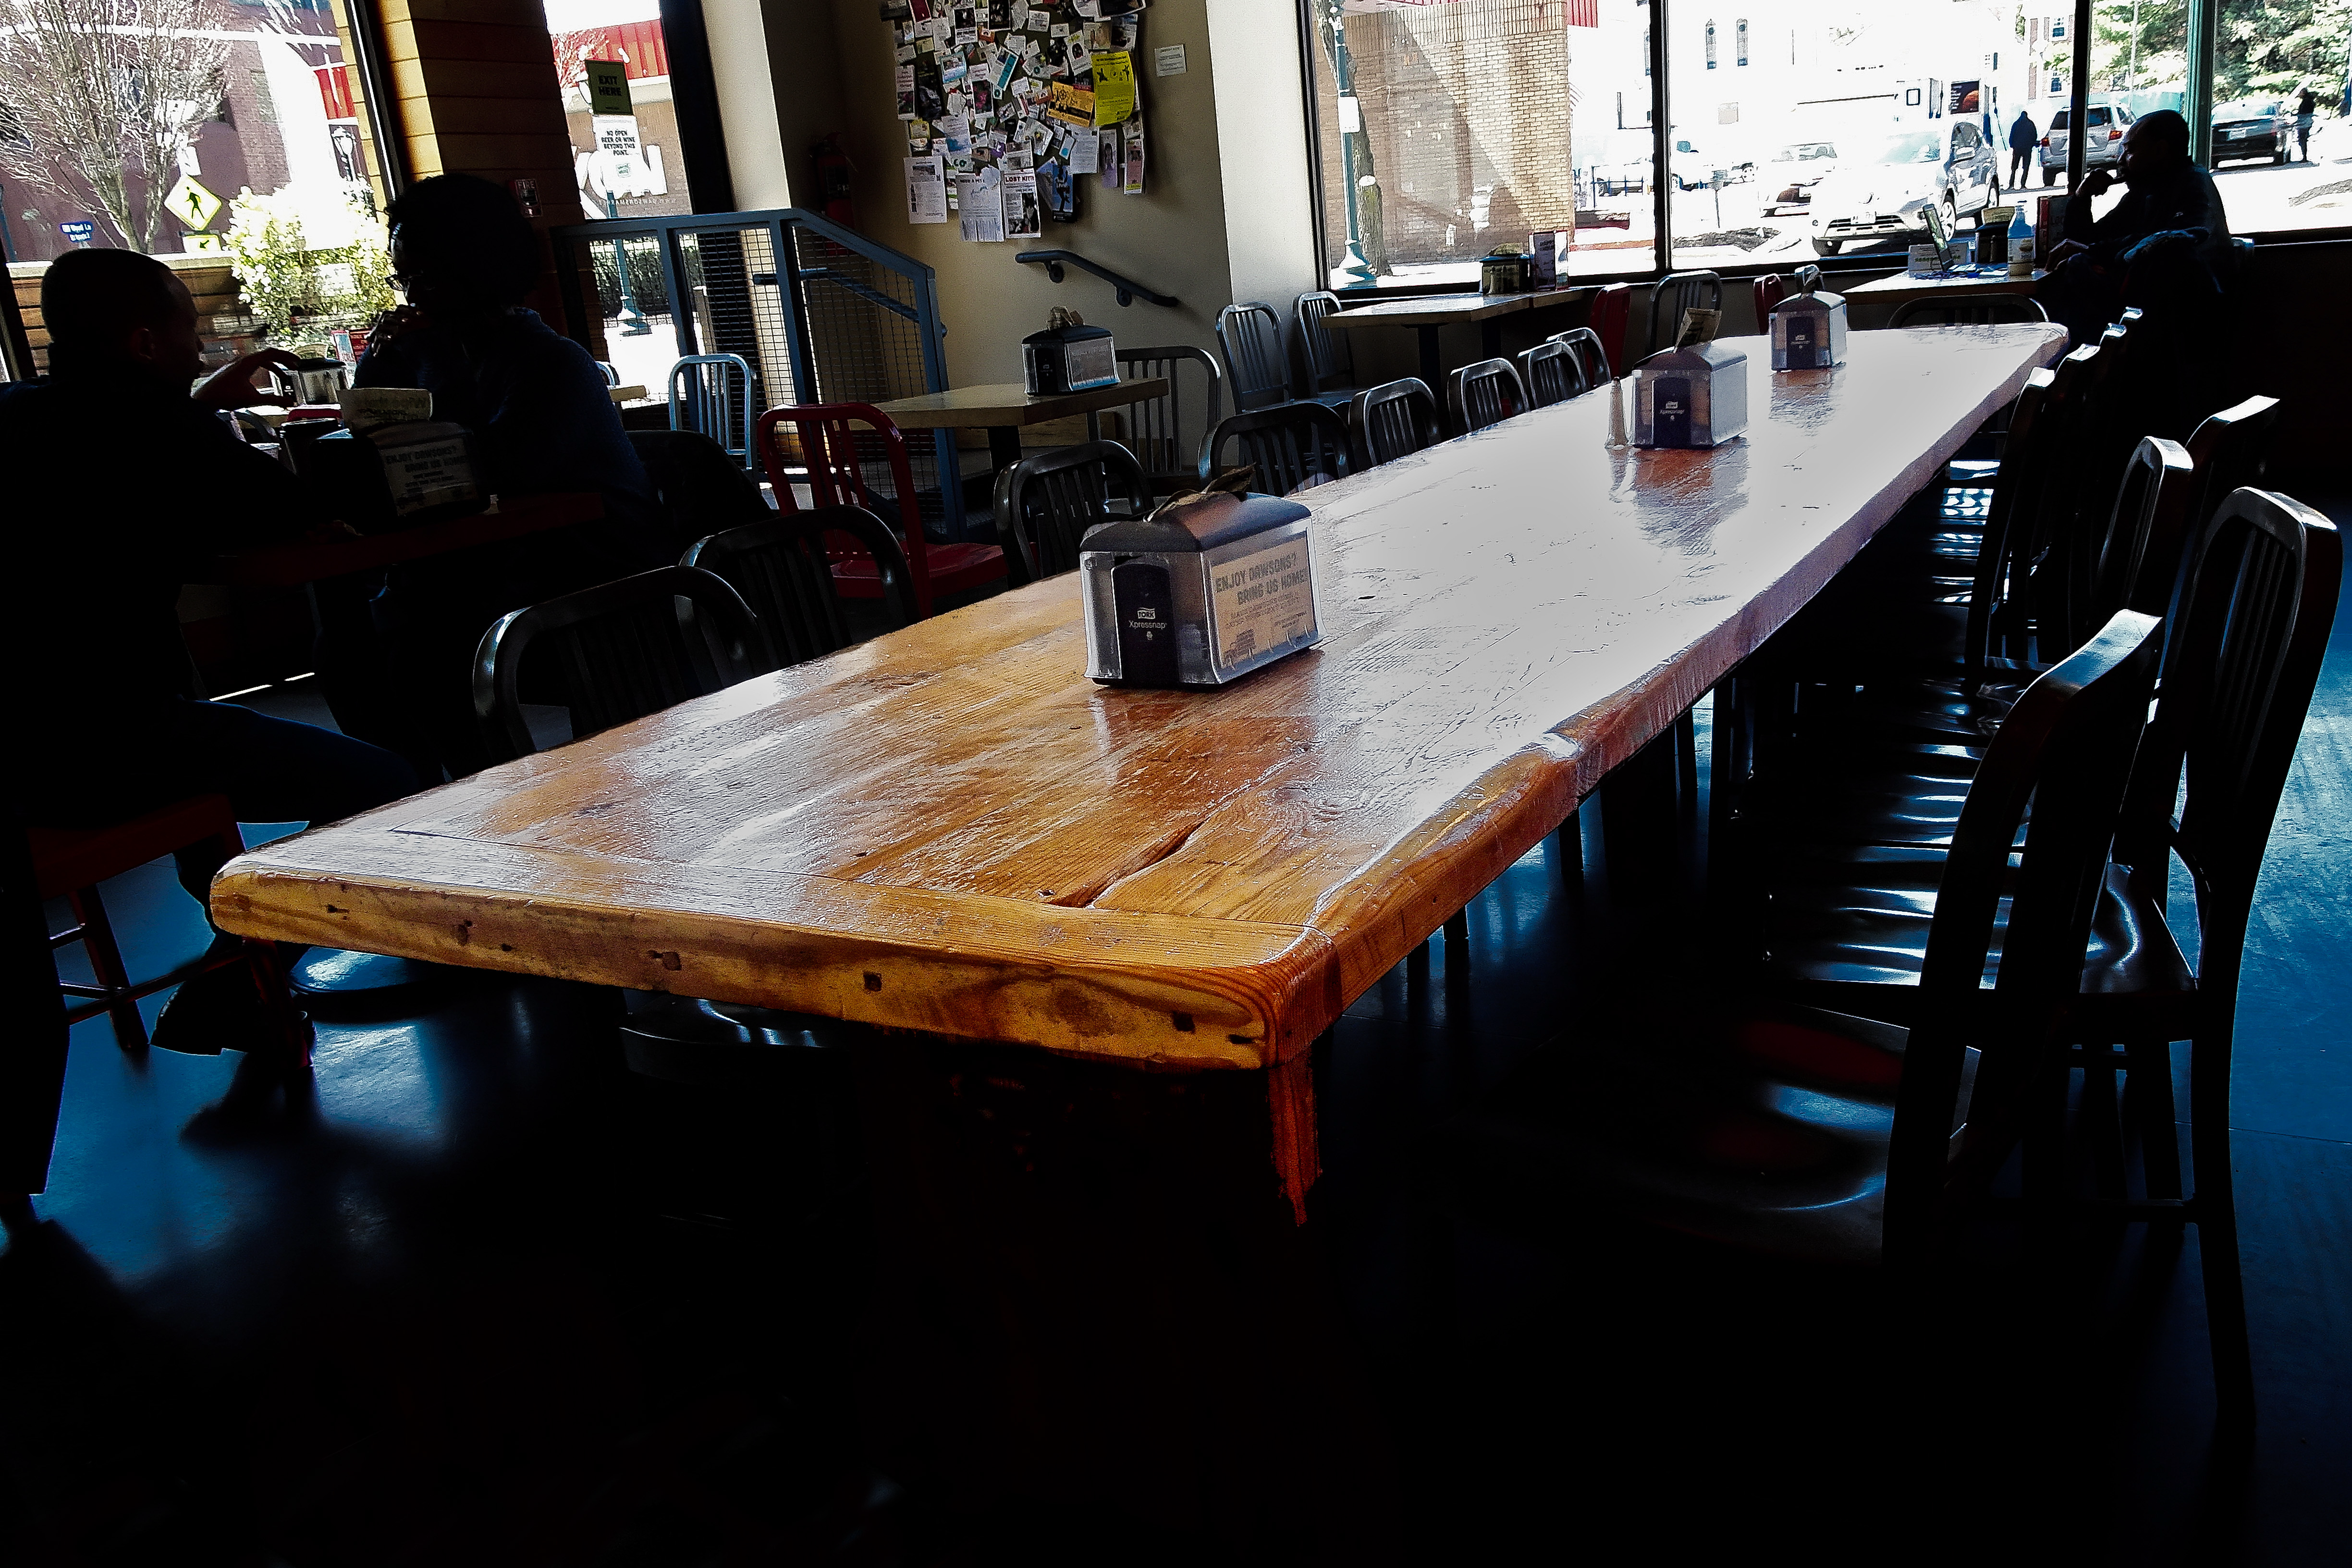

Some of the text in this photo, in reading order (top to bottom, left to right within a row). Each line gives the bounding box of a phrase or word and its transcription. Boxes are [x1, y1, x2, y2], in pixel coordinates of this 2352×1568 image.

[599, 75, 618, 85] EXIT
[598, 86, 622, 96] HERE
[517, 181, 535, 189] FIRE
[386, 453, 412, 465] ENJOY
[1215, 552, 1296, 593] ENJOY DAWSONS?
[1237, 582, 1264, 605] BRING
[1266, 578, 1279, 594] US
[1128, 620, 1166, 630] Xpressnap
